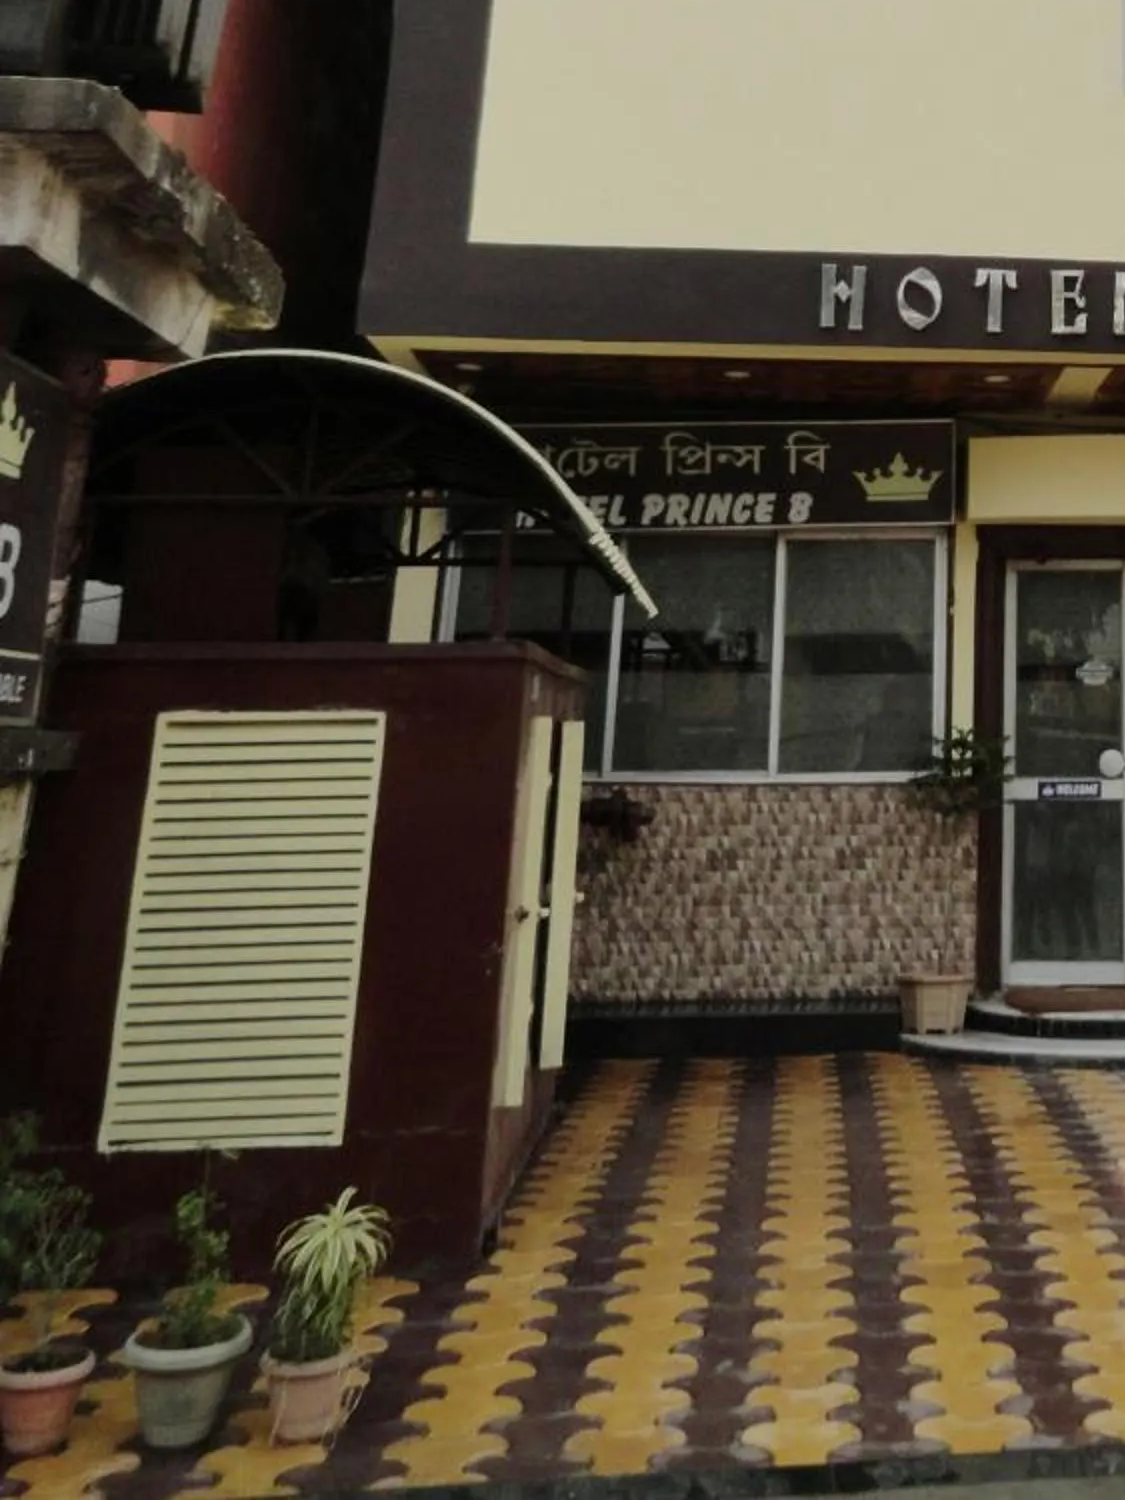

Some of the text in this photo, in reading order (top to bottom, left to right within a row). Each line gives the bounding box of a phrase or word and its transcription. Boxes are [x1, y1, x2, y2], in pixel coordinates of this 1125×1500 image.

[546, 437, 640, 478] টেল
[783, 430, 832, 475] বি
[640, 493, 774, 528] PRINCE
[787, 492, 815, 525] B
[1055, 783, 1098, 797] WELCOME
